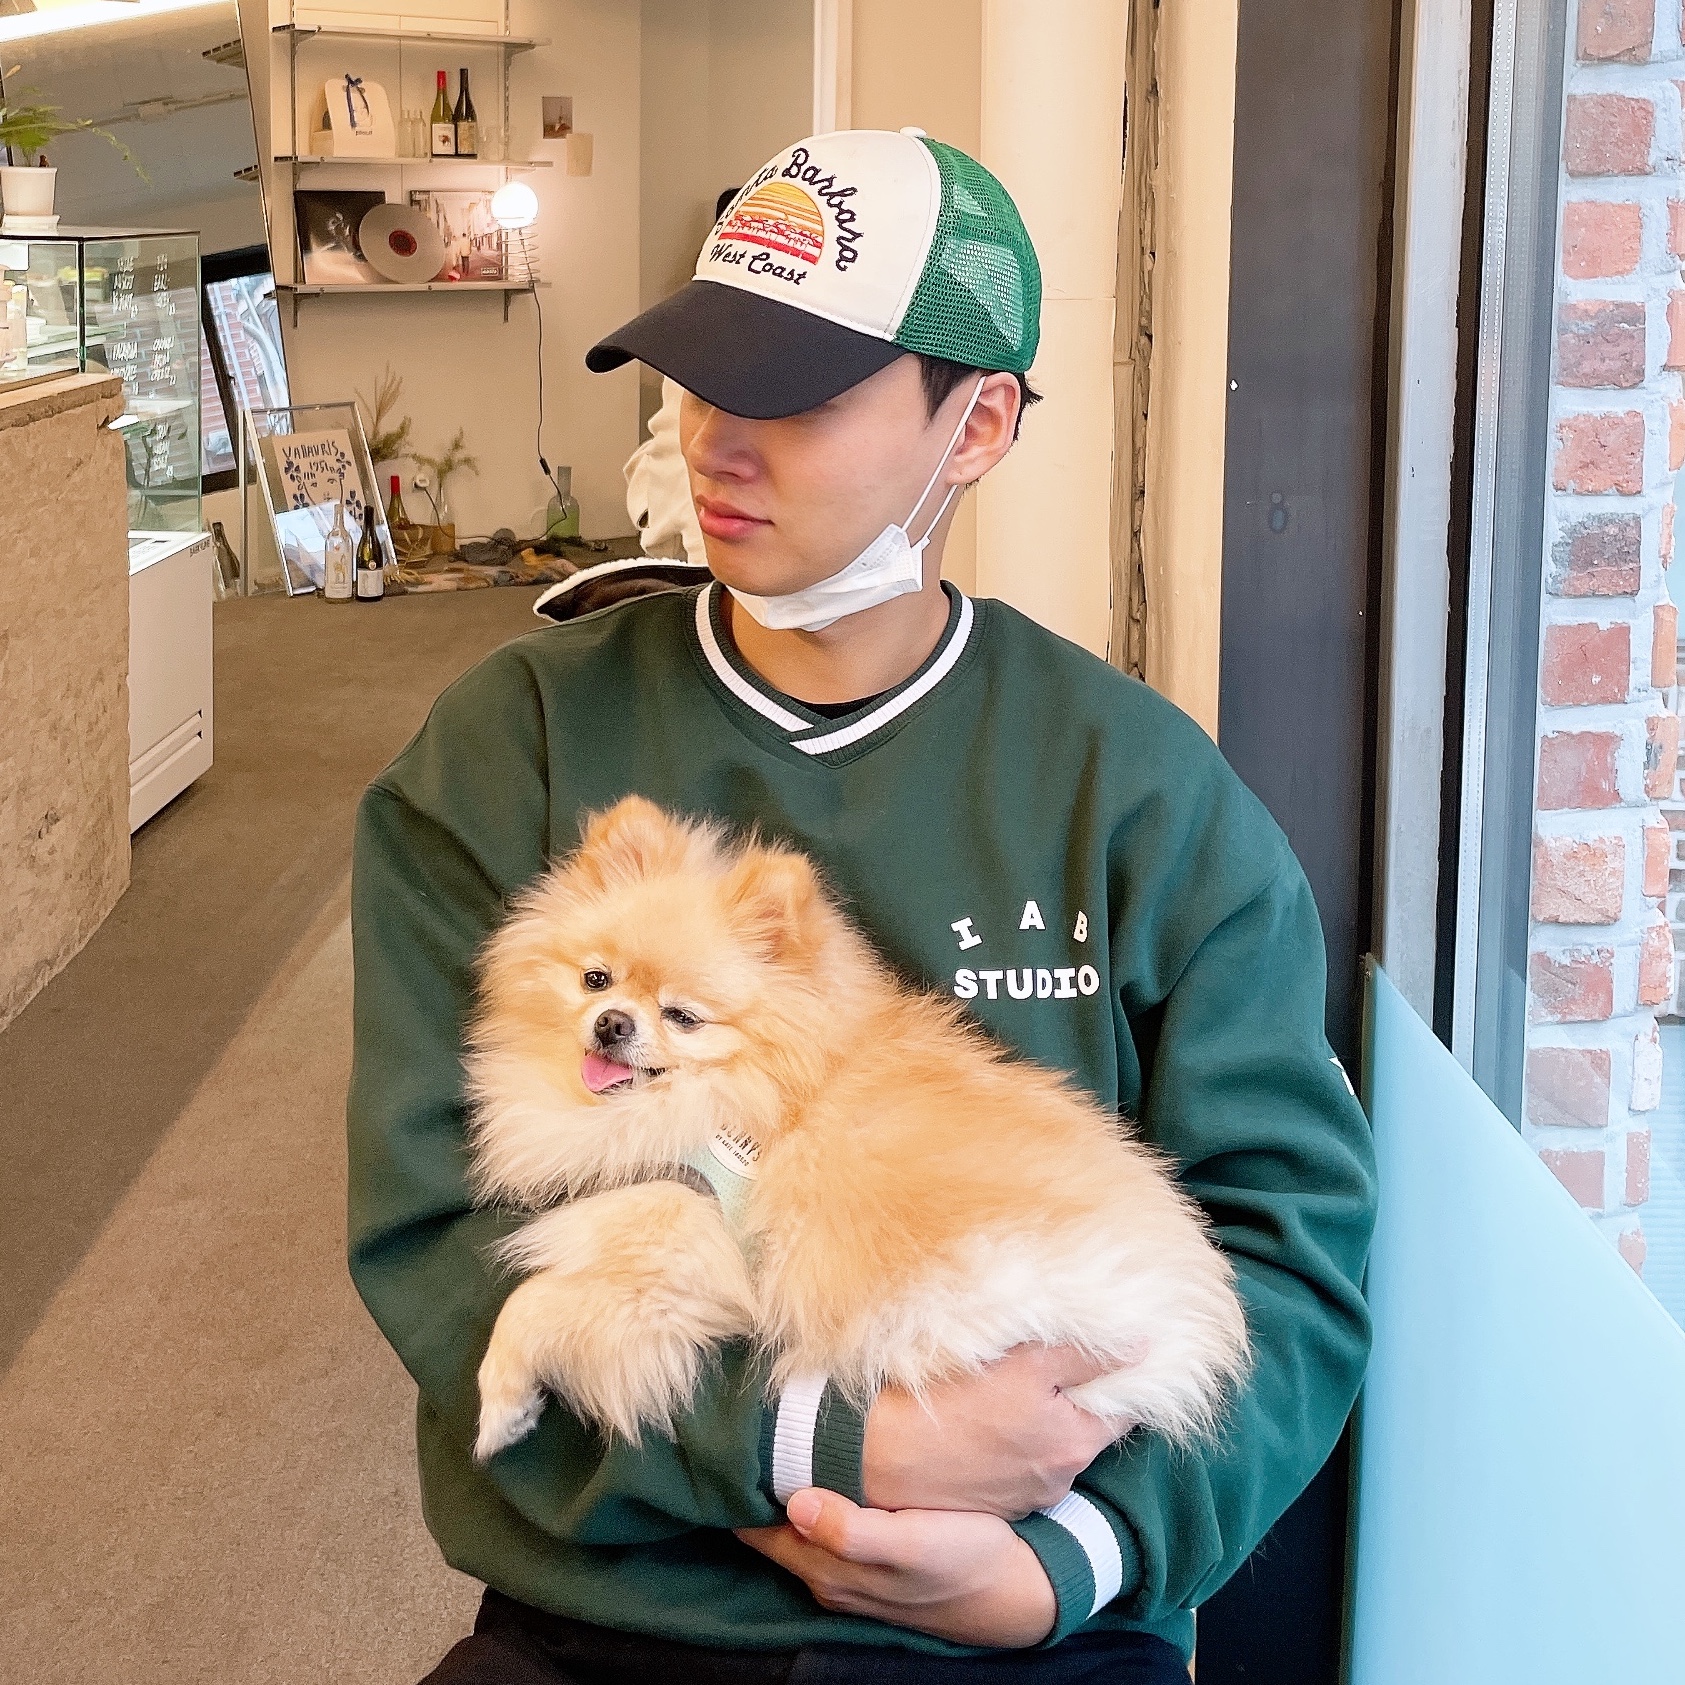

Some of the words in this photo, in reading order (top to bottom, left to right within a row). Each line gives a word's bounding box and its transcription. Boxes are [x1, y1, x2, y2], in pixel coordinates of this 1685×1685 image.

[781, 147, 865, 272] Barbara
[709, 243, 747, 265] West
[747, 251, 808, 285] Coast
[953, 964, 1100, 1000] STUDIO
